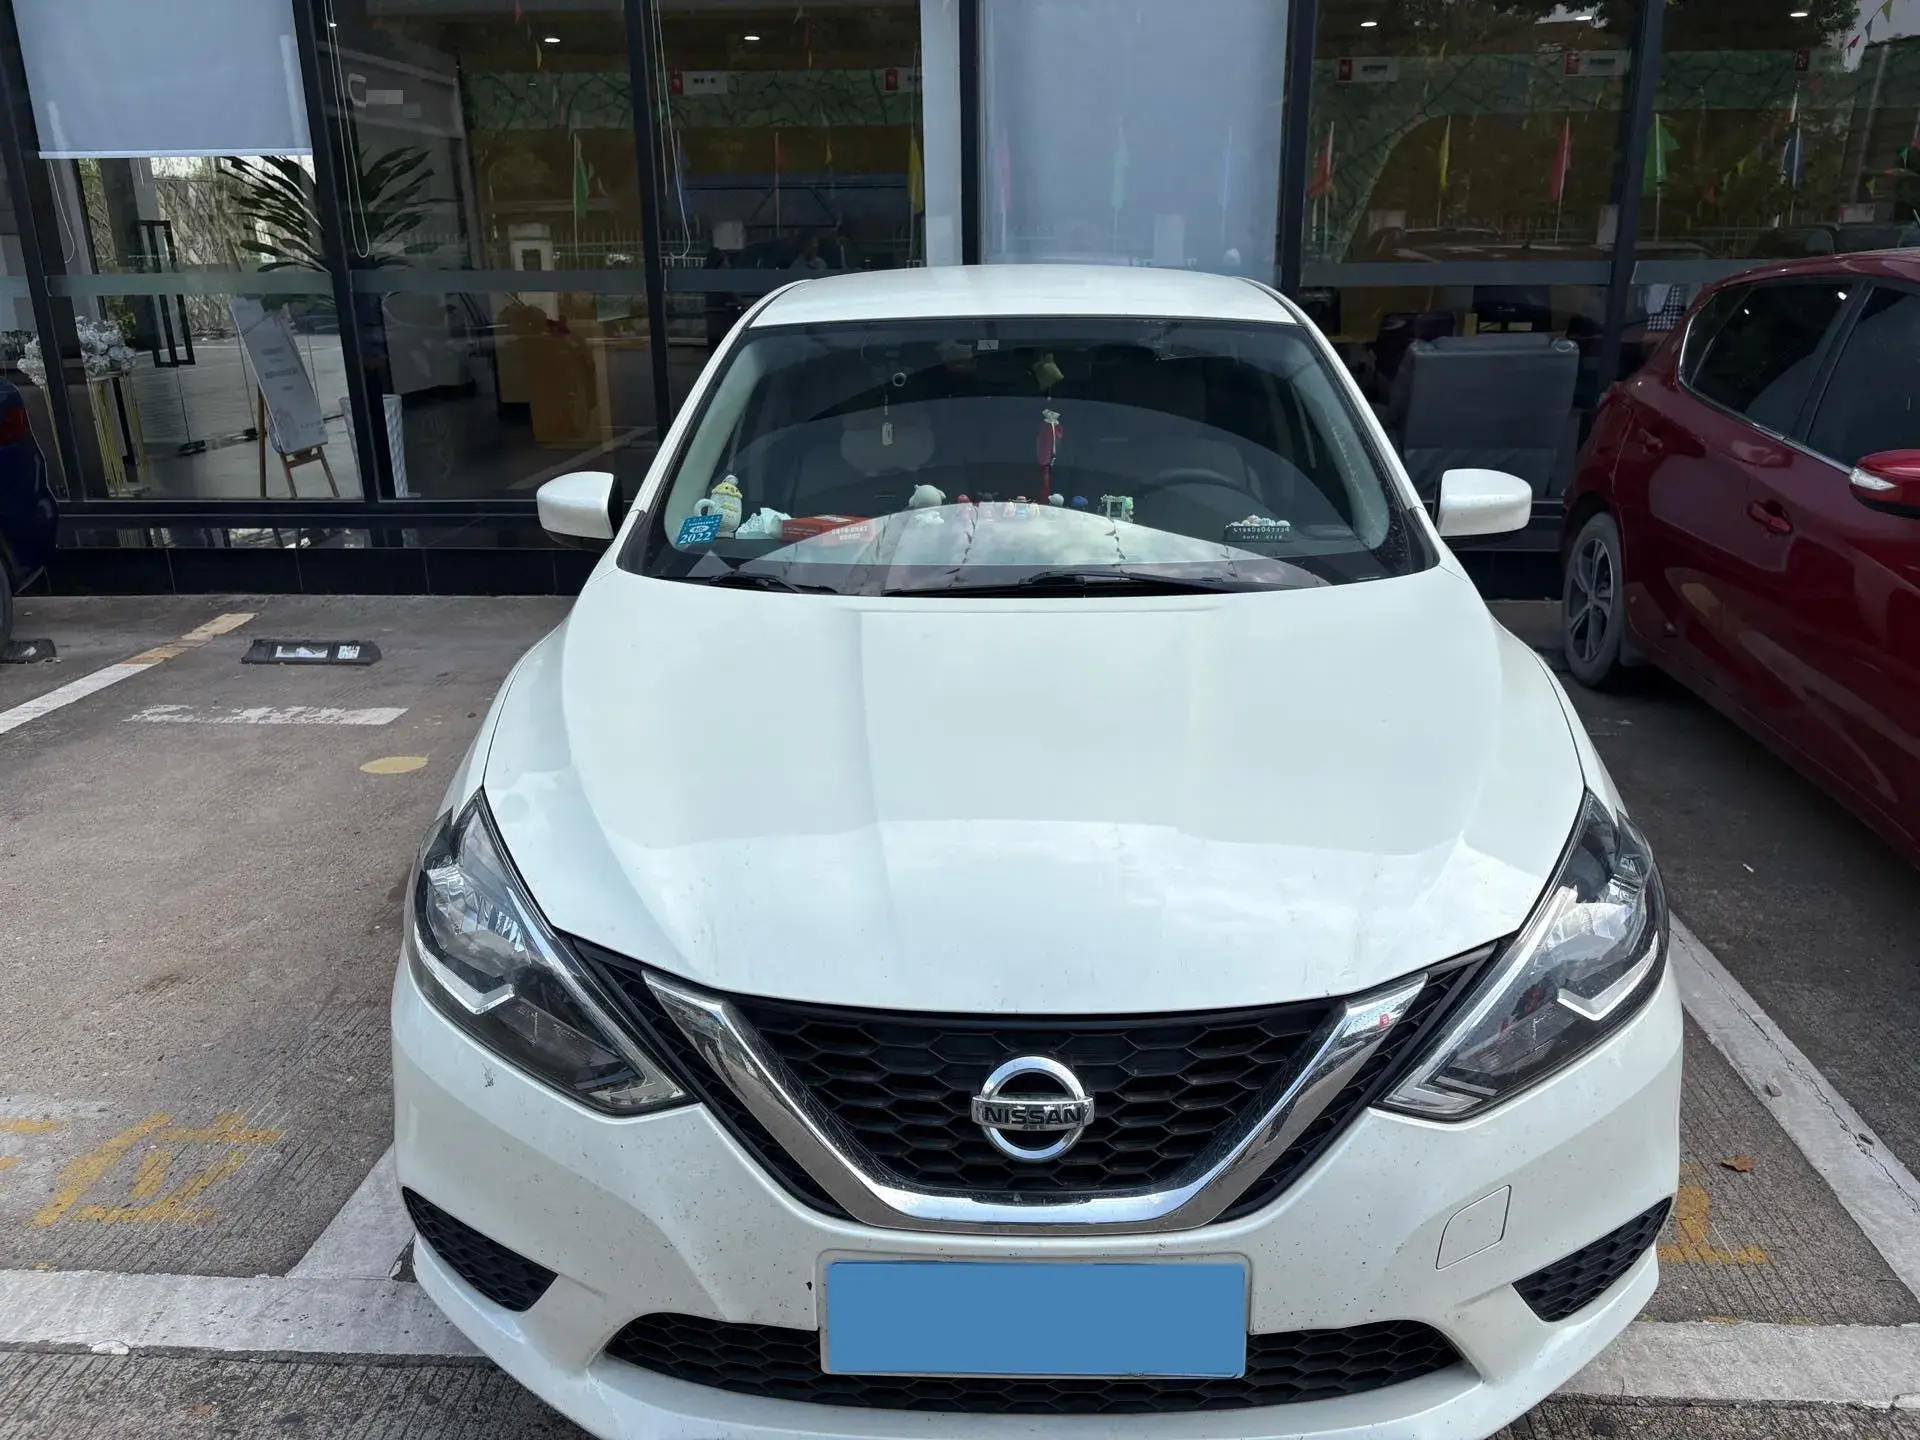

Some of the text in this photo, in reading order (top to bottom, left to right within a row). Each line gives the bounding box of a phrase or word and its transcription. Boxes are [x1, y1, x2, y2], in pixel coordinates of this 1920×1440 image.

[679, 532, 712, 544] 2022
[983, 1106, 1082, 1125] NISSAN
[0, 1111, 285, 1228] 位
